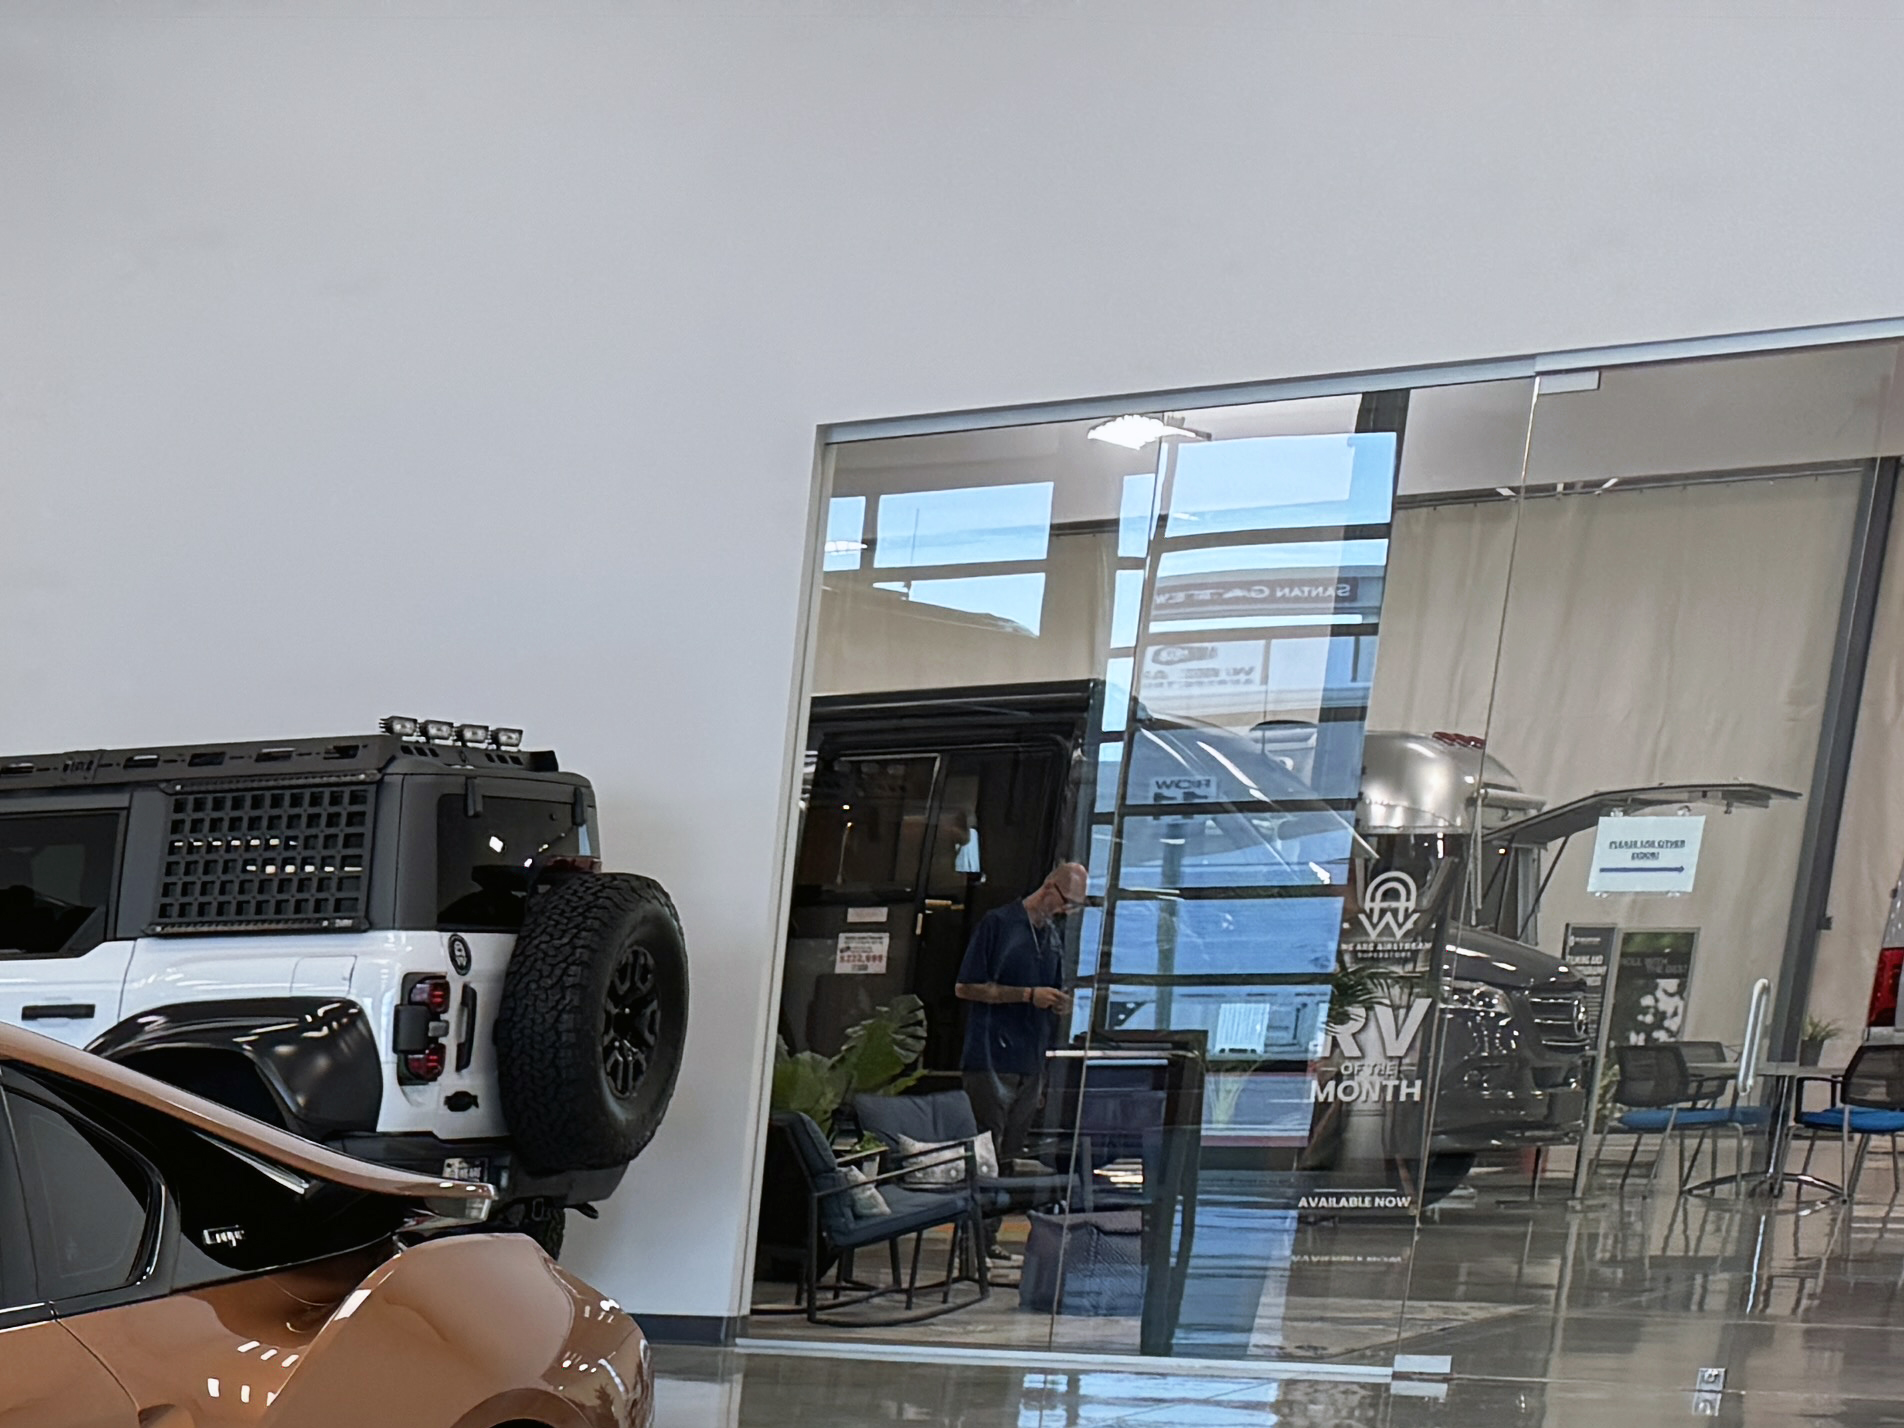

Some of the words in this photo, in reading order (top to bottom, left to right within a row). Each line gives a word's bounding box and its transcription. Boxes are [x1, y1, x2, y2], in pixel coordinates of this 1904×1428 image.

[1321, 998, 1433, 1057] RV
[1340, 1061, 1365, 1077] OF
[1366, 1061, 1399, 1077] THE
[1312, 1079, 1422, 1103] MONTH
[1298, 1196, 1372, 1208] AVAILABLE
[1374, 1196, 1412, 1208] NOW
